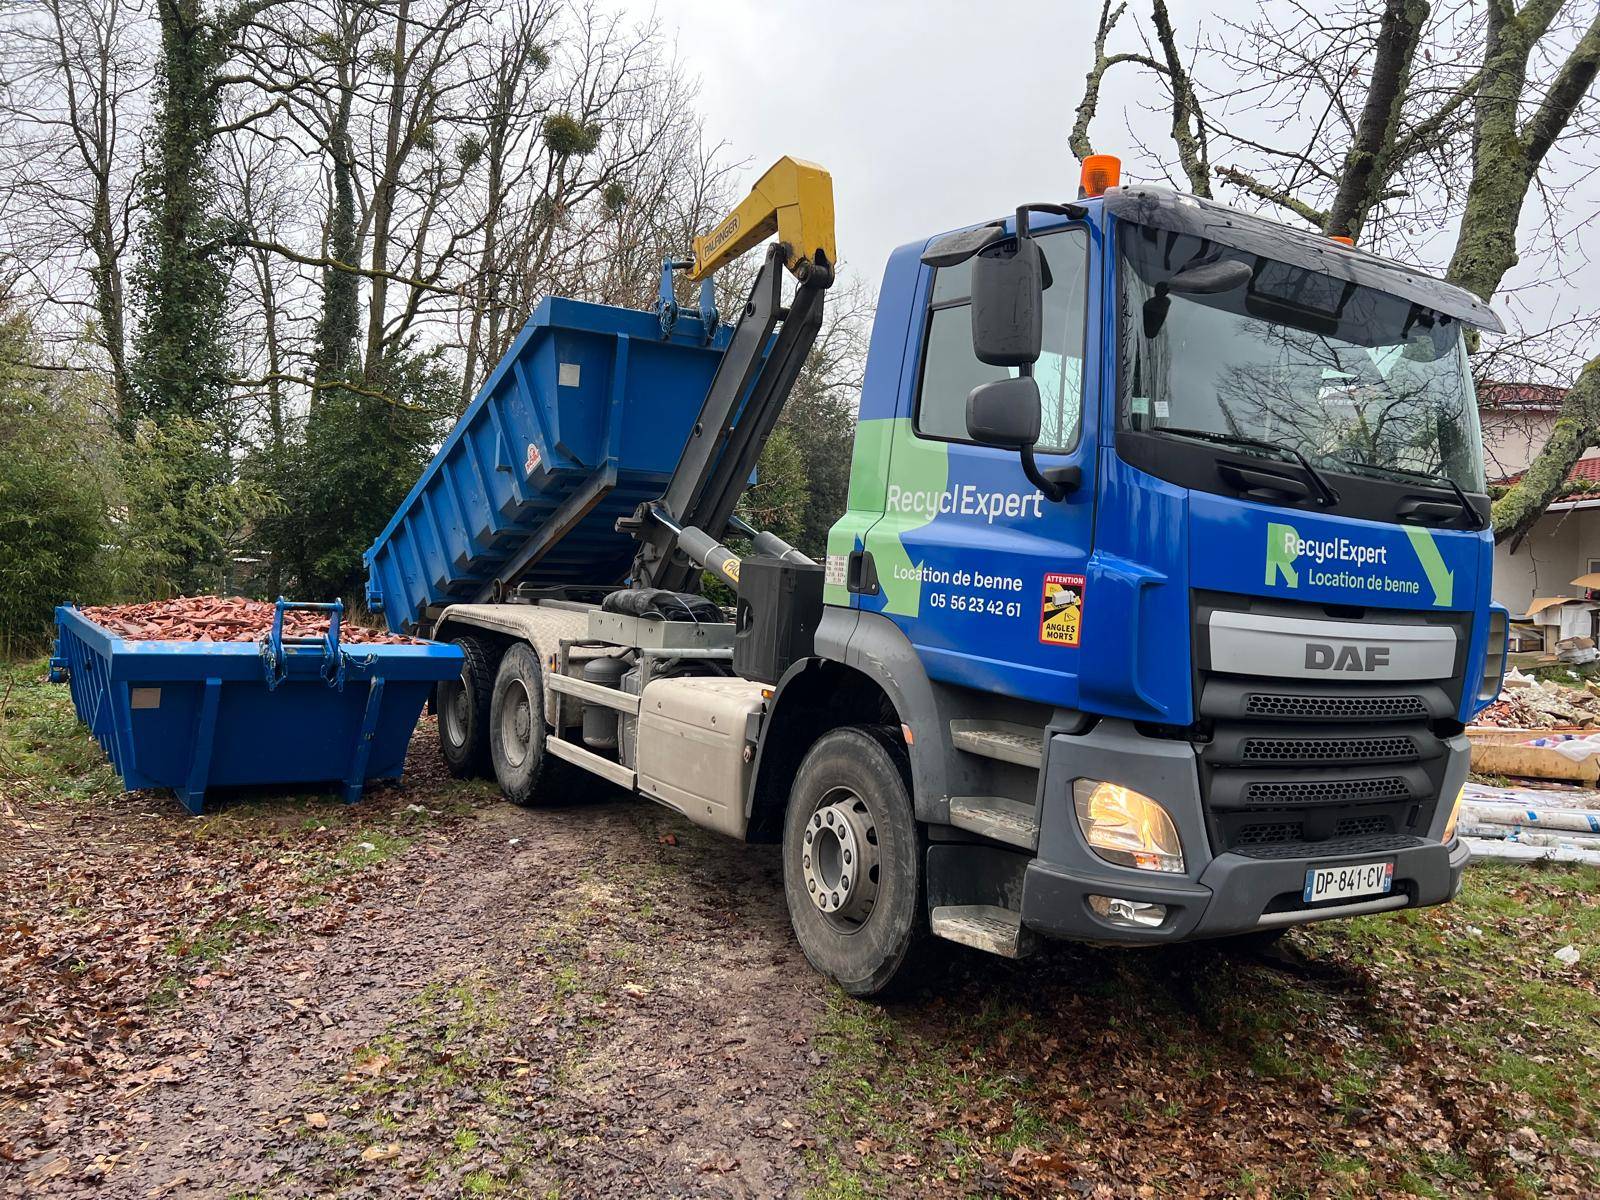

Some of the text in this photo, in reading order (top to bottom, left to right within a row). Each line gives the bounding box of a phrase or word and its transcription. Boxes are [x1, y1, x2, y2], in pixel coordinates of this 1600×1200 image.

[704, 219, 738, 257] PALFINGER
[887, 484, 1044, 524] RecyclExpert
[1284, 532, 1387, 567] RecyclExpert
[894, 564, 1023, 592] Location de benne
[1046, 576, 1083, 584] ATTENTION
[1308, 568, 1419, 594] Location de benne
[930, 592, 1021, 617] 05 56 23 42 61
[1046, 623, 1075, 633] ANGLES
[1046, 631, 1073, 641] MORTS
[1304, 643, 1389, 672] DAF
[1316, 866, 1383, 894] DP-841-CV
